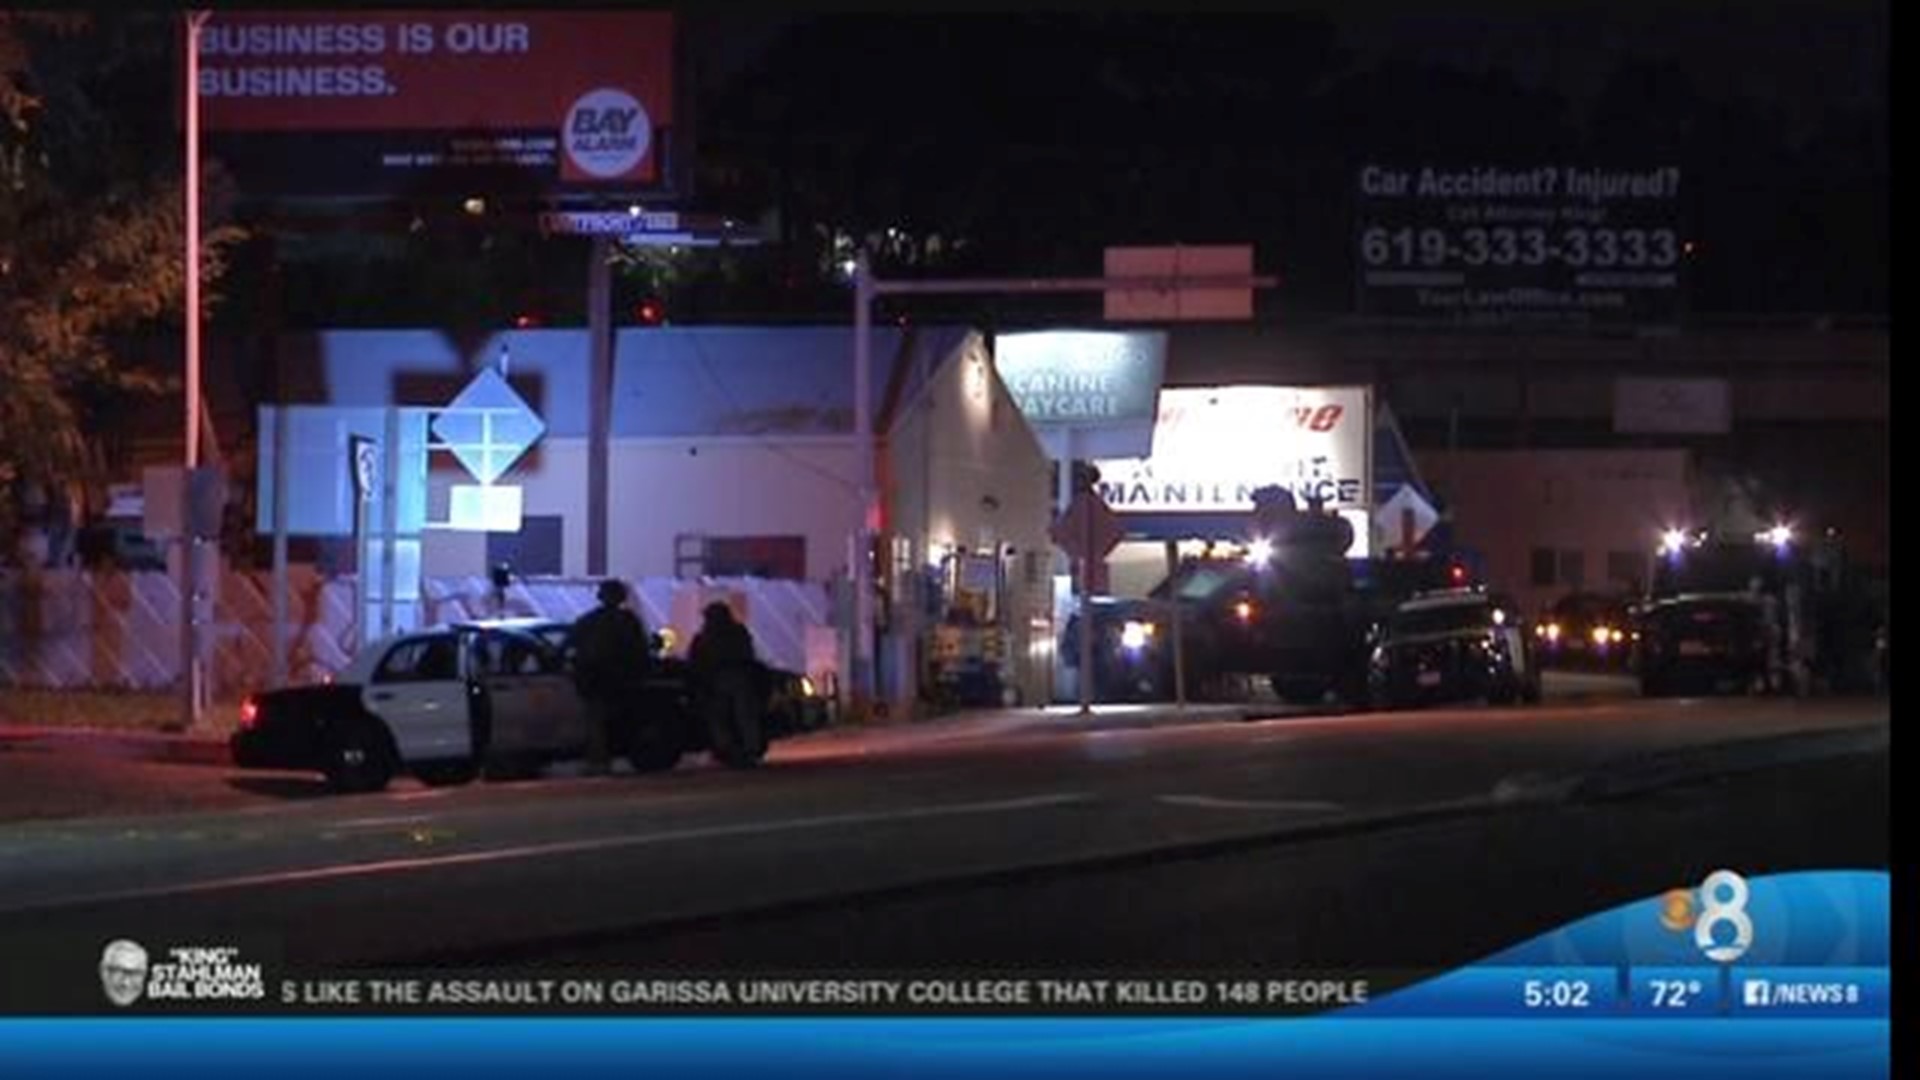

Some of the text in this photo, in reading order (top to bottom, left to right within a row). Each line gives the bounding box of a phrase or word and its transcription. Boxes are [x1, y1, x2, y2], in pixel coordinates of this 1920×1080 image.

[198, 23, 529, 54] BUSINESS IS OUR
[198, 67, 396, 97] BUSINESS.
[573, 107, 638, 134] BAY
[1361, 166, 1680, 201] Car Accident? Injured?
[1361, 227, 1677, 267] 619-333-3333
[1013, 373, 1114, 394] CANINE
[1017, 394, 1118, 416] AYCARE
[1098, 478, 1361, 506] MAINTENNCE
